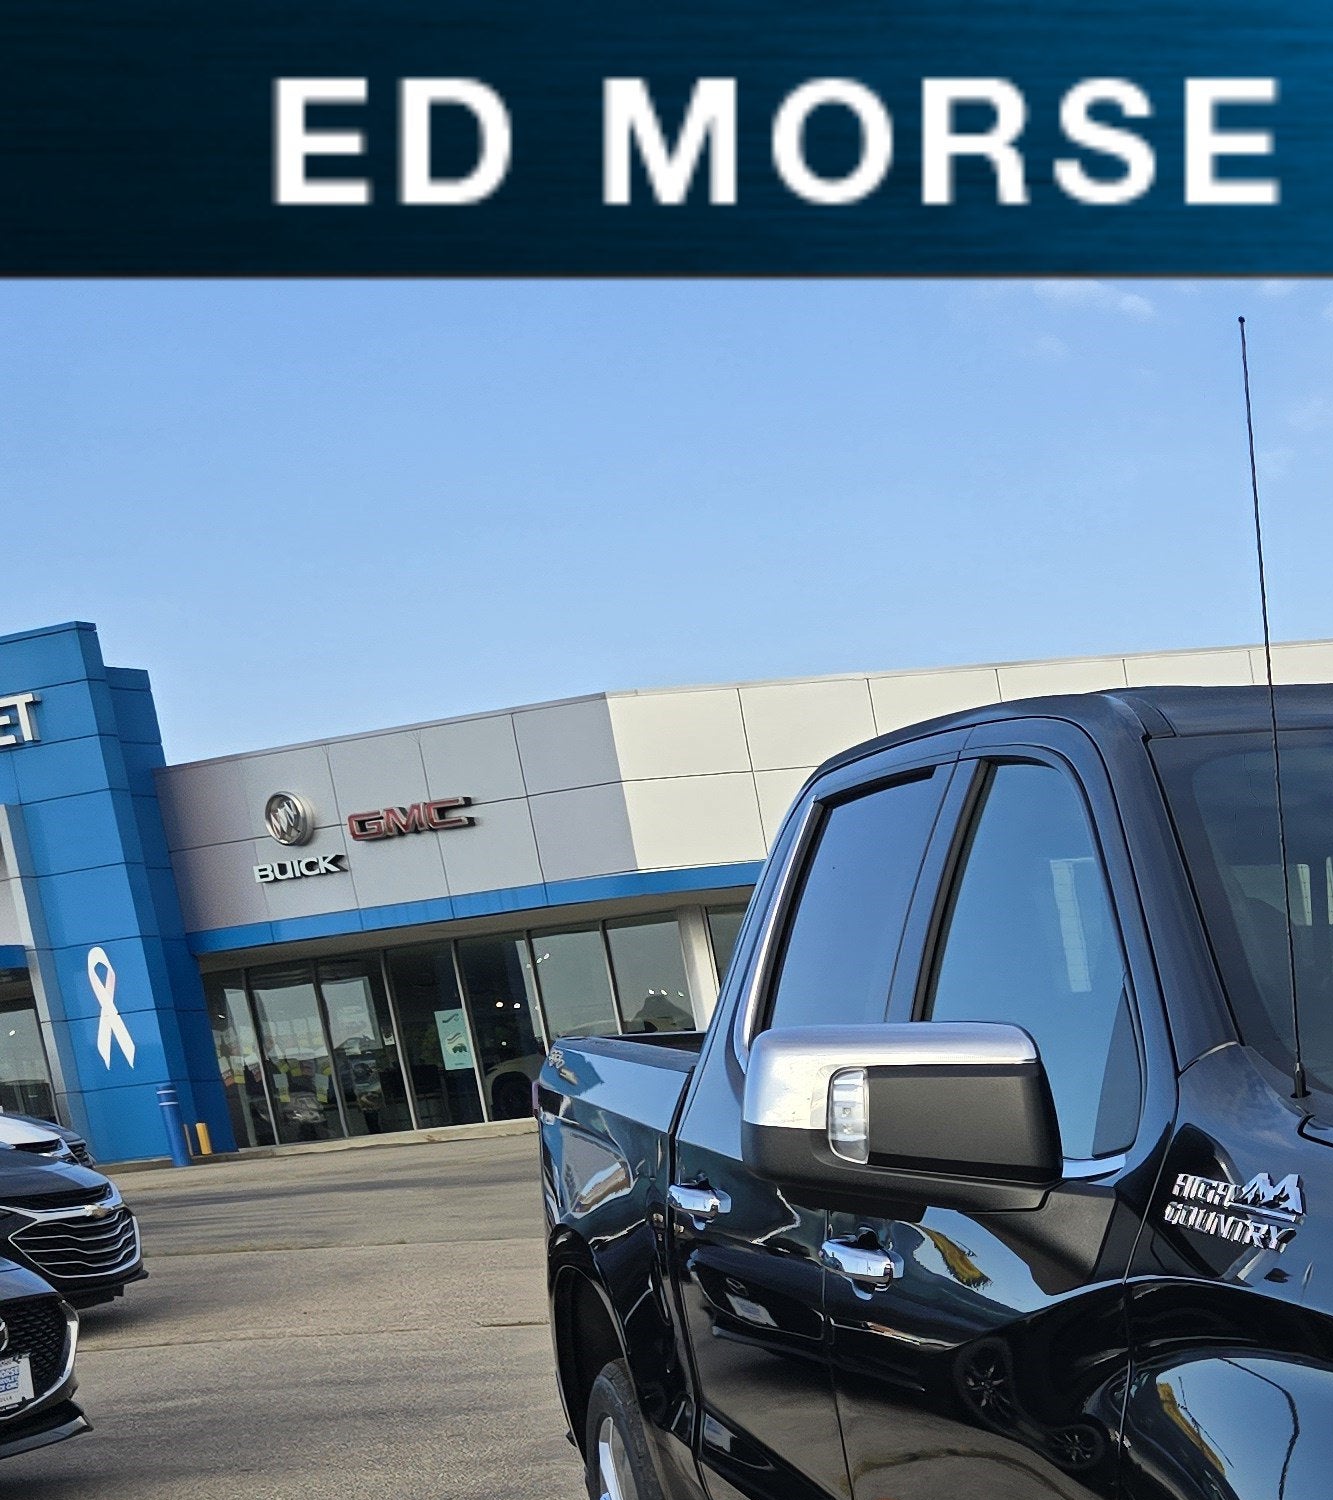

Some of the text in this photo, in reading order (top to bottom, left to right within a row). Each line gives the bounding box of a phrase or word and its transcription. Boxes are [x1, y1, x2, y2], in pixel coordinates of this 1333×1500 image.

[347, 796, 473, 842] GMC
[253, 854, 346, 884] BUICK
[1171, 1173, 1240, 1209] HIGH
[1164, 1201, 1297, 1254] COUNTRY
